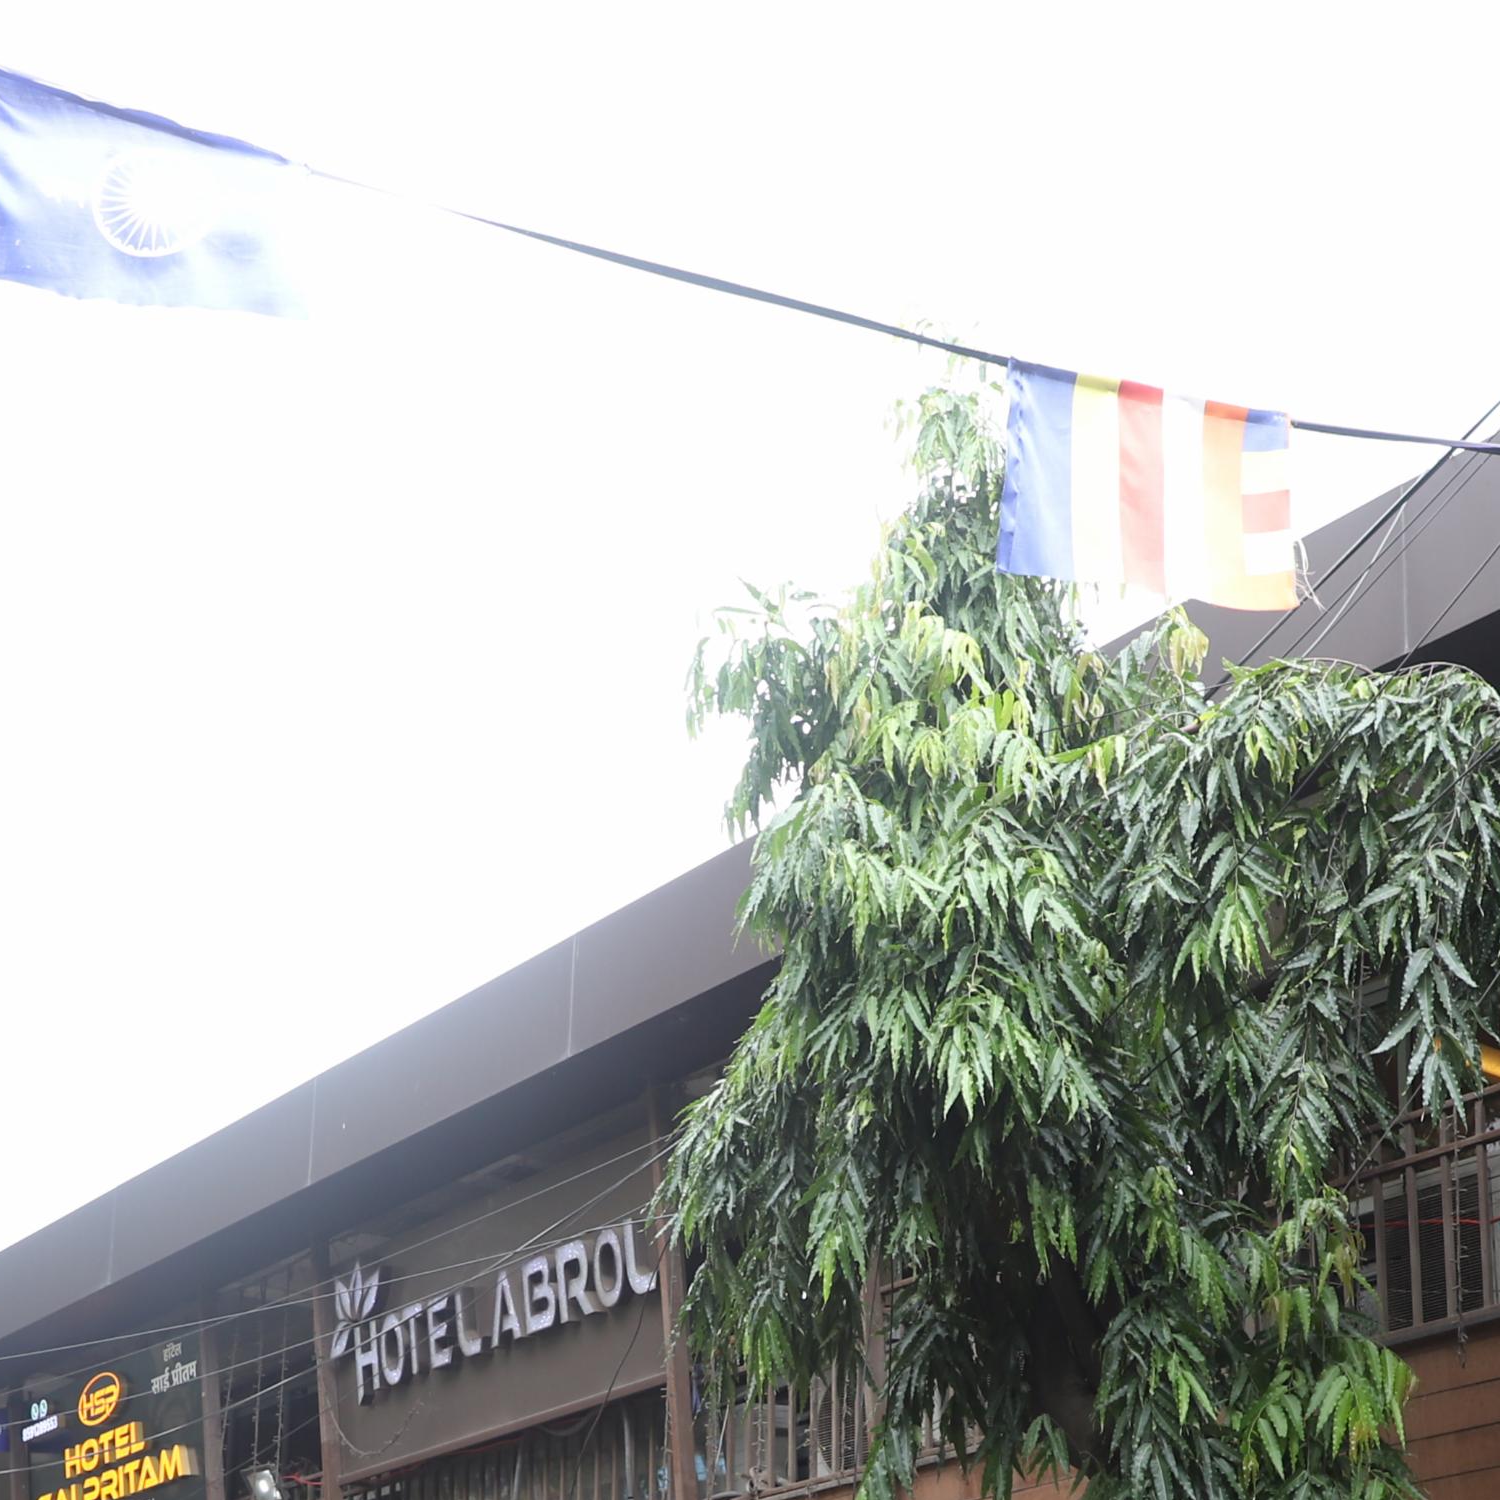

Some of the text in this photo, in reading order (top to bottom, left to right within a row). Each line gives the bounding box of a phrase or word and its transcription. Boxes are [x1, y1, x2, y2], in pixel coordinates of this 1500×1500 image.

[353, 1218, 657, 1405] HOTEL ABROL
[64, 1421, 146, 1479] HOTEL
